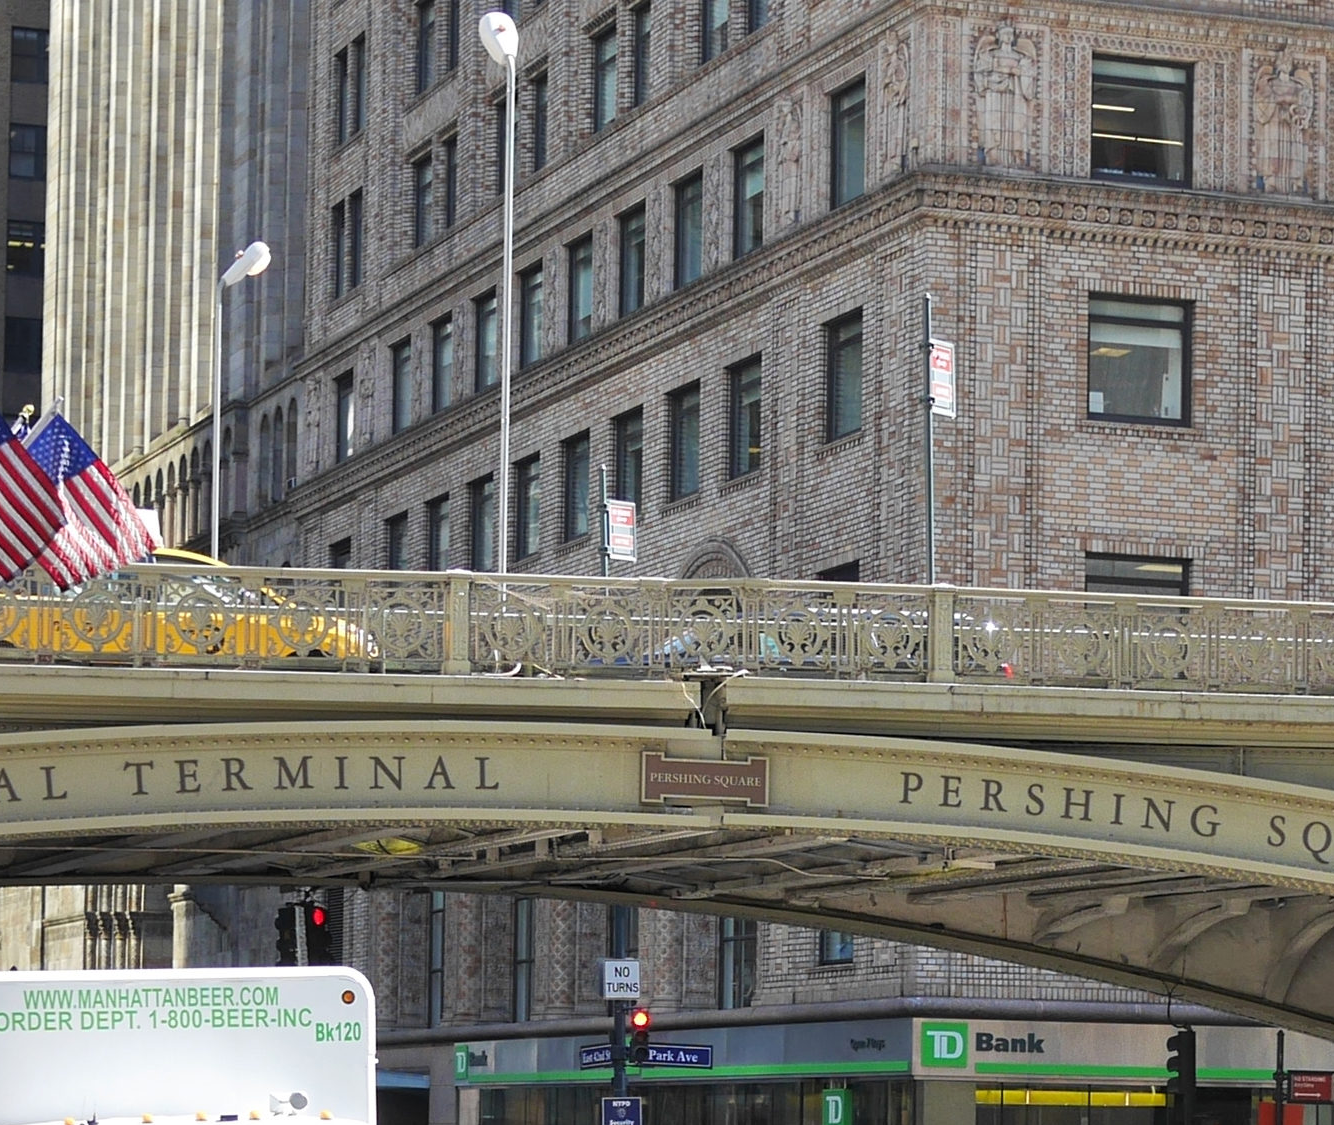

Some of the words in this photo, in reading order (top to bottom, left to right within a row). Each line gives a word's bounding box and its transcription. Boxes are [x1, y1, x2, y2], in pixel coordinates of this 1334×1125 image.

[123, 754, 500, 796] TERMINAL
[650, 772, 712, 787] PERSHING
[713, 774, 762, 788] SQUARE
[900, 771, 1222, 838] PERSHING
[614, 966, 630, 978] NO
[23, 986, 279, 1010] WWW.MANHATTANBEER.COM
[606, 982, 639, 993] TURNS
[80, 1009, 141, 1031] DEPT.
[148, 1007, 313, 1030] 1-800-BEER-INC
[315, 1021, 362, 1042] Bk120
[926, 1030, 964, 1059] TD
[975, 1032, 1045, 1054] Bank
[582, 1051, 593, 1064] East
[648, 1049, 674, 1062] Park
[677, 1051, 699, 1063] Ave
